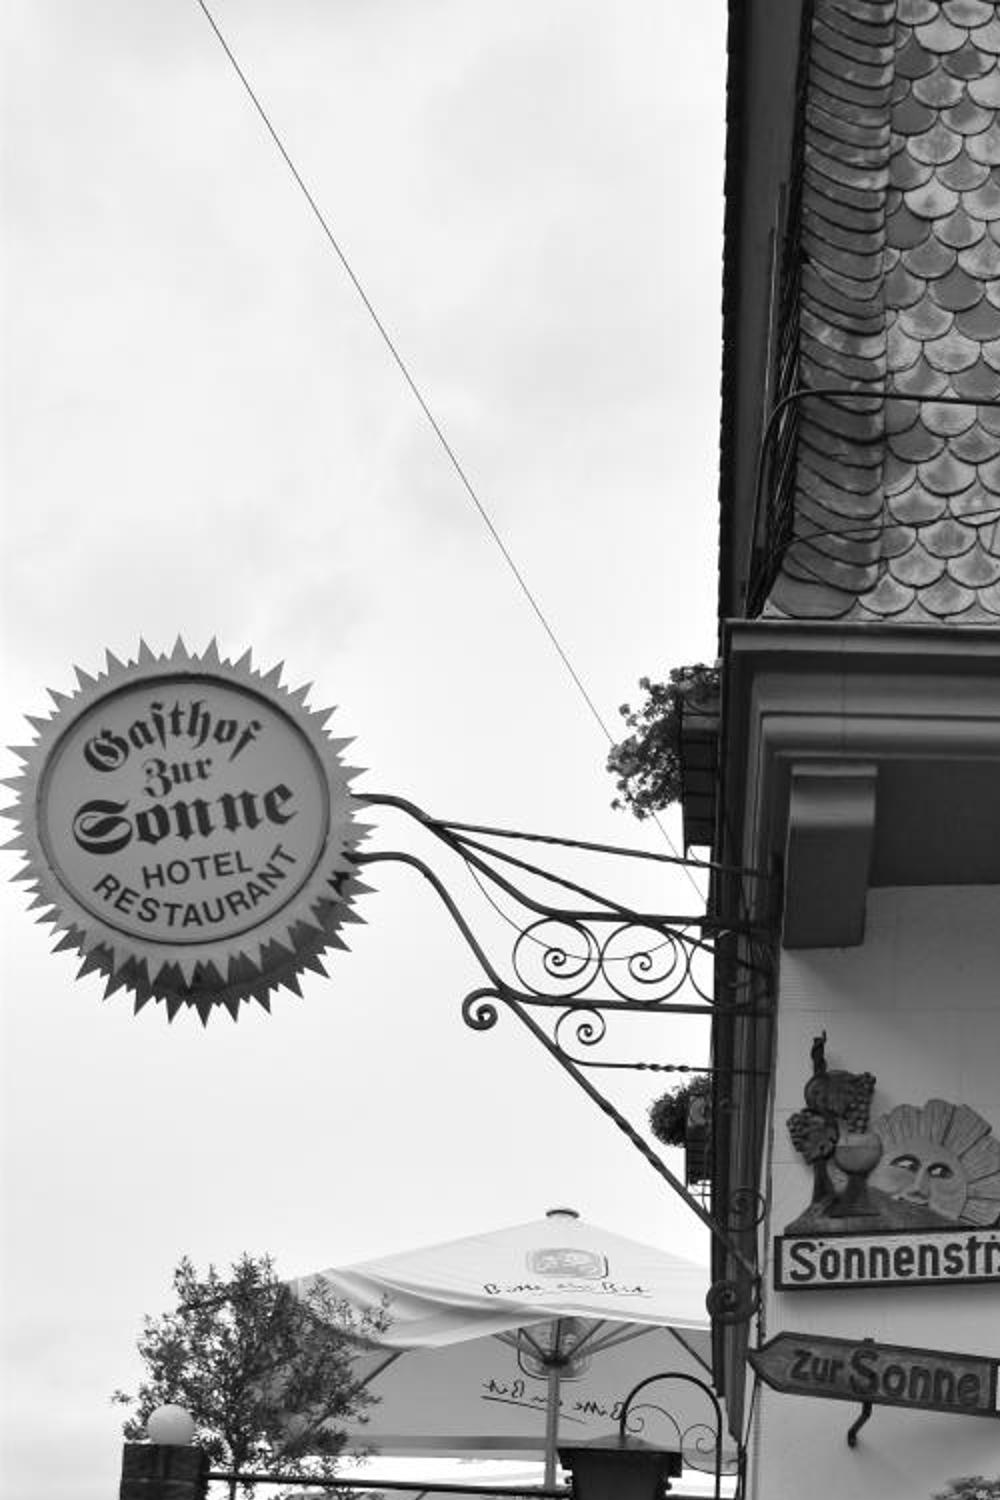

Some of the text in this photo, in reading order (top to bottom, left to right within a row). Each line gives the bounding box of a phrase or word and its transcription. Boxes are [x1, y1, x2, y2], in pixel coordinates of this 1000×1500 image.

[83, 700, 263, 773] Gasthof
[143, 757, 213, 797] Zur
[73, 784, 299, 855] Sonne
[93, 843, 298, 928] RESTAURANT
[142, 851, 253, 889] HOTEL
[850, 1350, 981, 1409] Sonne
